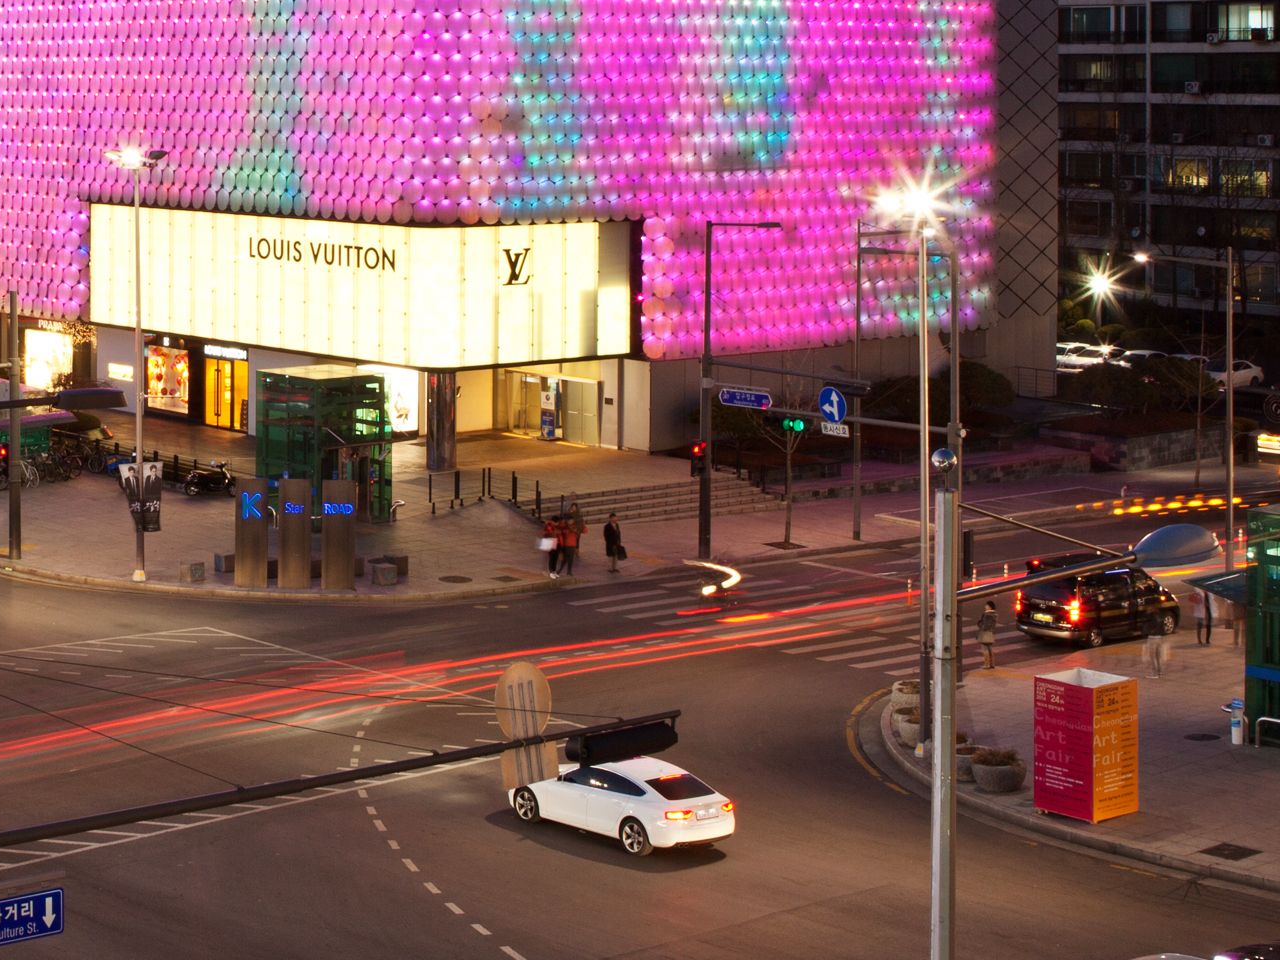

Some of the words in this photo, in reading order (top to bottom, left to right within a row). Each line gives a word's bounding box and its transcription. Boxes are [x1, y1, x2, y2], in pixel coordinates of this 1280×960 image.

[250, 237, 302, 262] LOUIS
[310, 242, 396, 272] VUITTON
[502, 248, 531, 286] LV
[241, 491, 262, 520] K
[285, 502, 304, 514] Star
[323, 503, 353, 515] ROAD
[1035, 726, 1066, 744] Art
[1093, 731, 1118, 747] Art
[1035, 744, 1074, 764] Fair
[1093, 751, 1124, 768] Fair
[26, 922, 39, 934] St.
